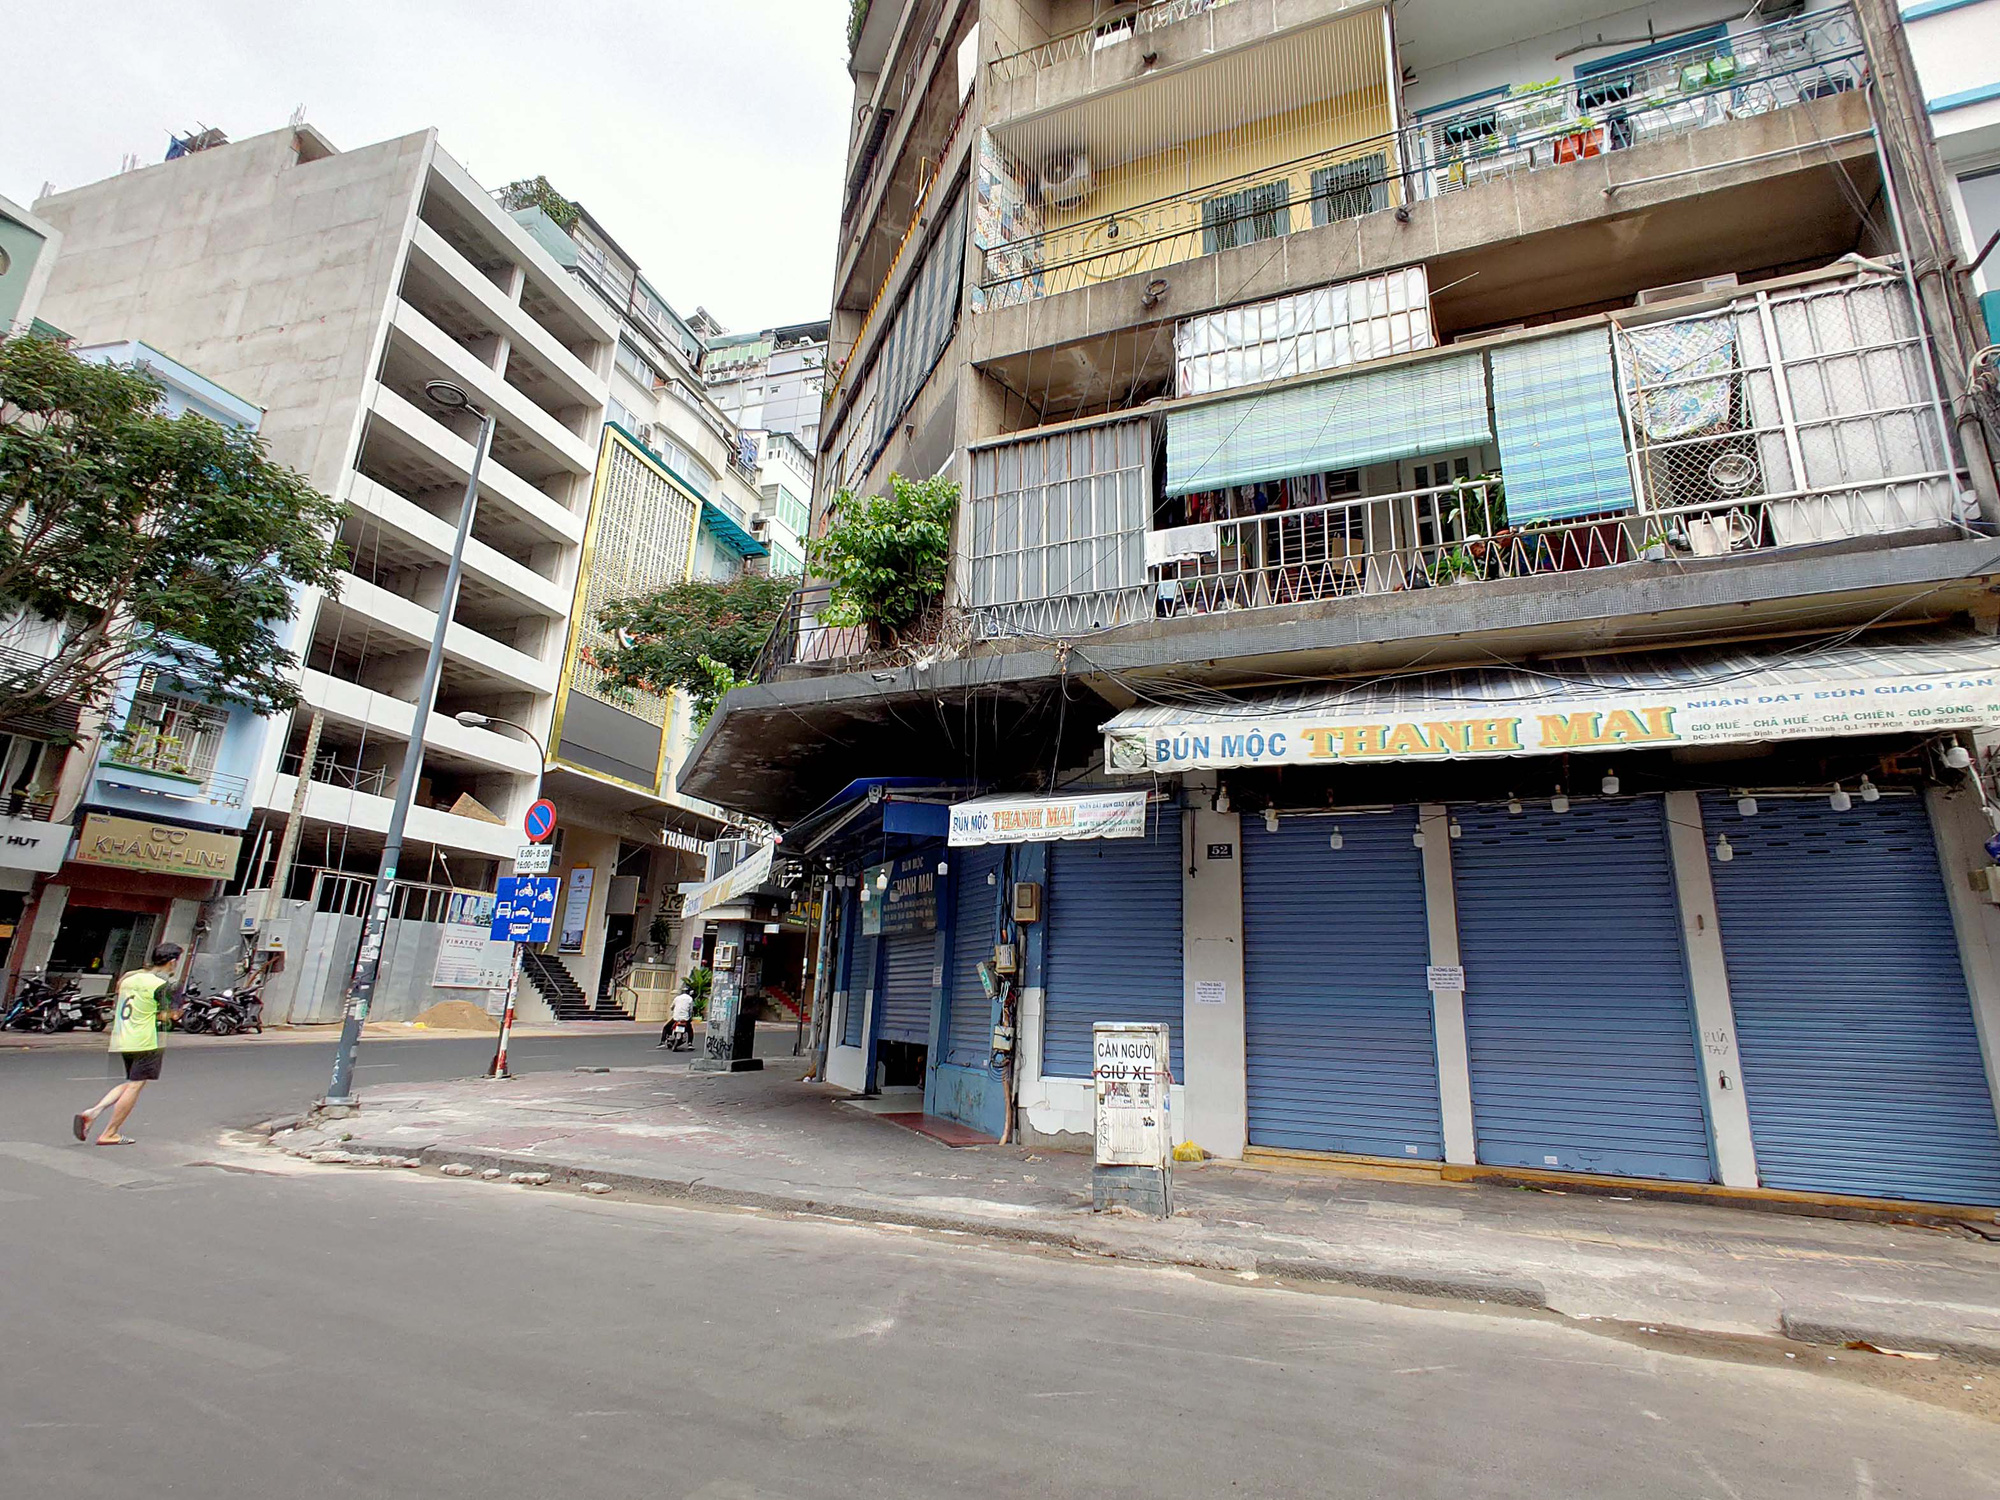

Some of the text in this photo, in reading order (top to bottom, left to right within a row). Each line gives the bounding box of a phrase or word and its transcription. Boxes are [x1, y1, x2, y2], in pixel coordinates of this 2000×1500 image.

[1814, 688, 1865, 699] BÚN
[1874, 683, 1933, 695] GIAO
[1753, 717, 1779, 728] CHẢ
[1155, 706, 1681, 763] BÚN MỘC THANH MAI
[953, 805, 1077, 834] BÚN MỘC THANH MAI
[7, 835, 41, 848] HUT
[661, 827, 698, 854] THÀNH
[1210, 845, 1229, 855] 52
[445, 938, 485, 947] VINATECH
[121, 994, 135, 1020] 6
[1121, 1040, 1154, 1060] NGƯỜI
[1704, 1044, 1729, 1056] TAY
[1132, 1065, 1153, 1081] XE
